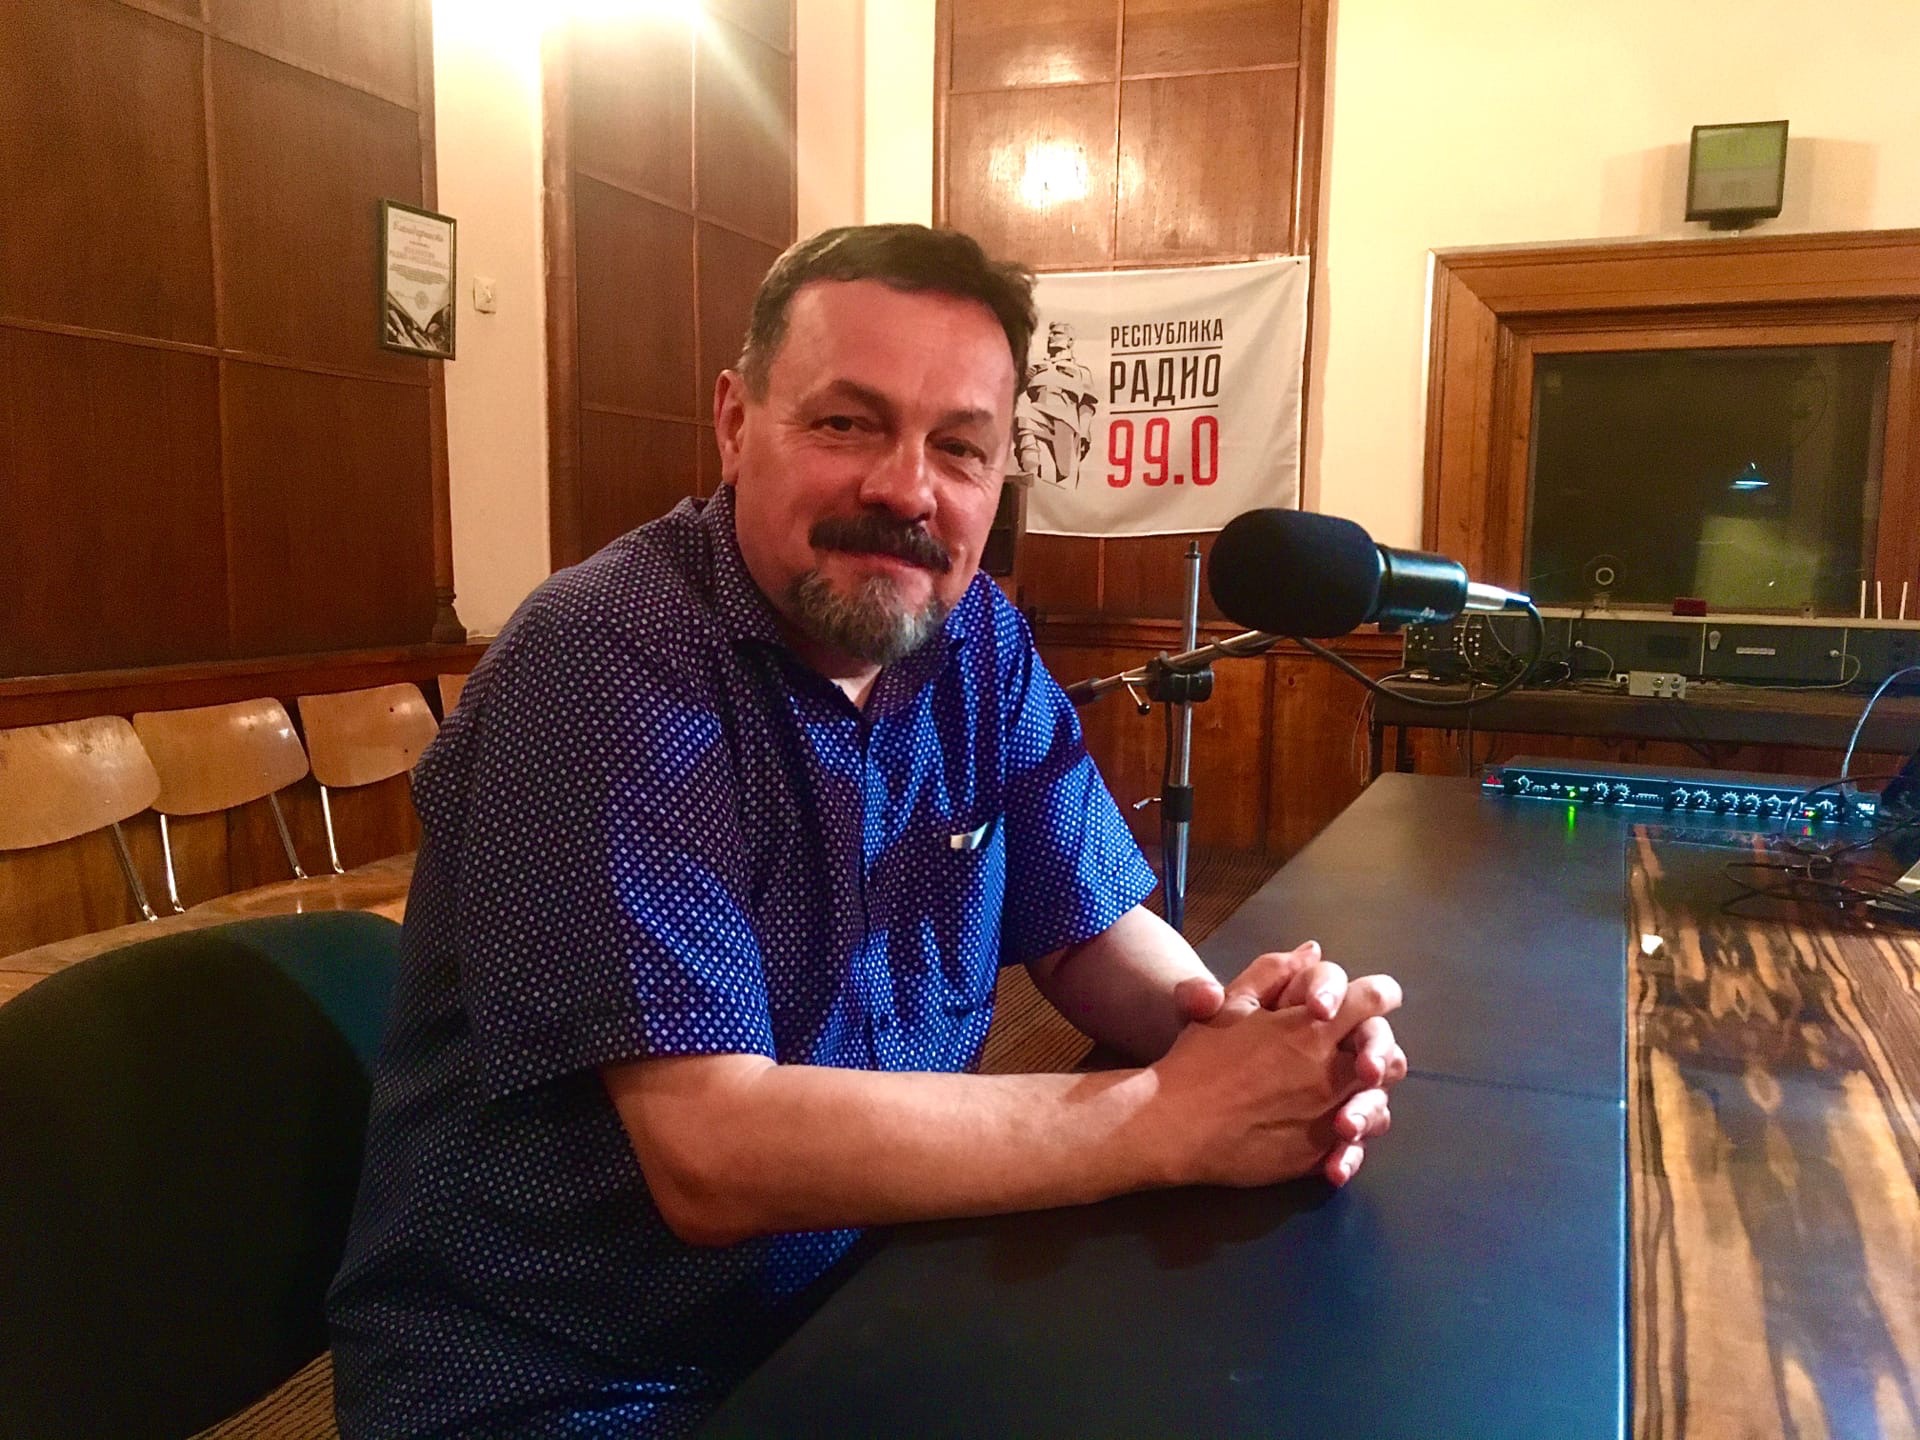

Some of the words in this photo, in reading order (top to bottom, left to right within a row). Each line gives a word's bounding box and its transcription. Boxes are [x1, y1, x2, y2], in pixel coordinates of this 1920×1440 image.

[1111, 318, 1223, 348] РЕСПУБЛИКА
[1110, 354, 1221, 407] РАДИО
[1107, 415, 1219, 489] 99.0
